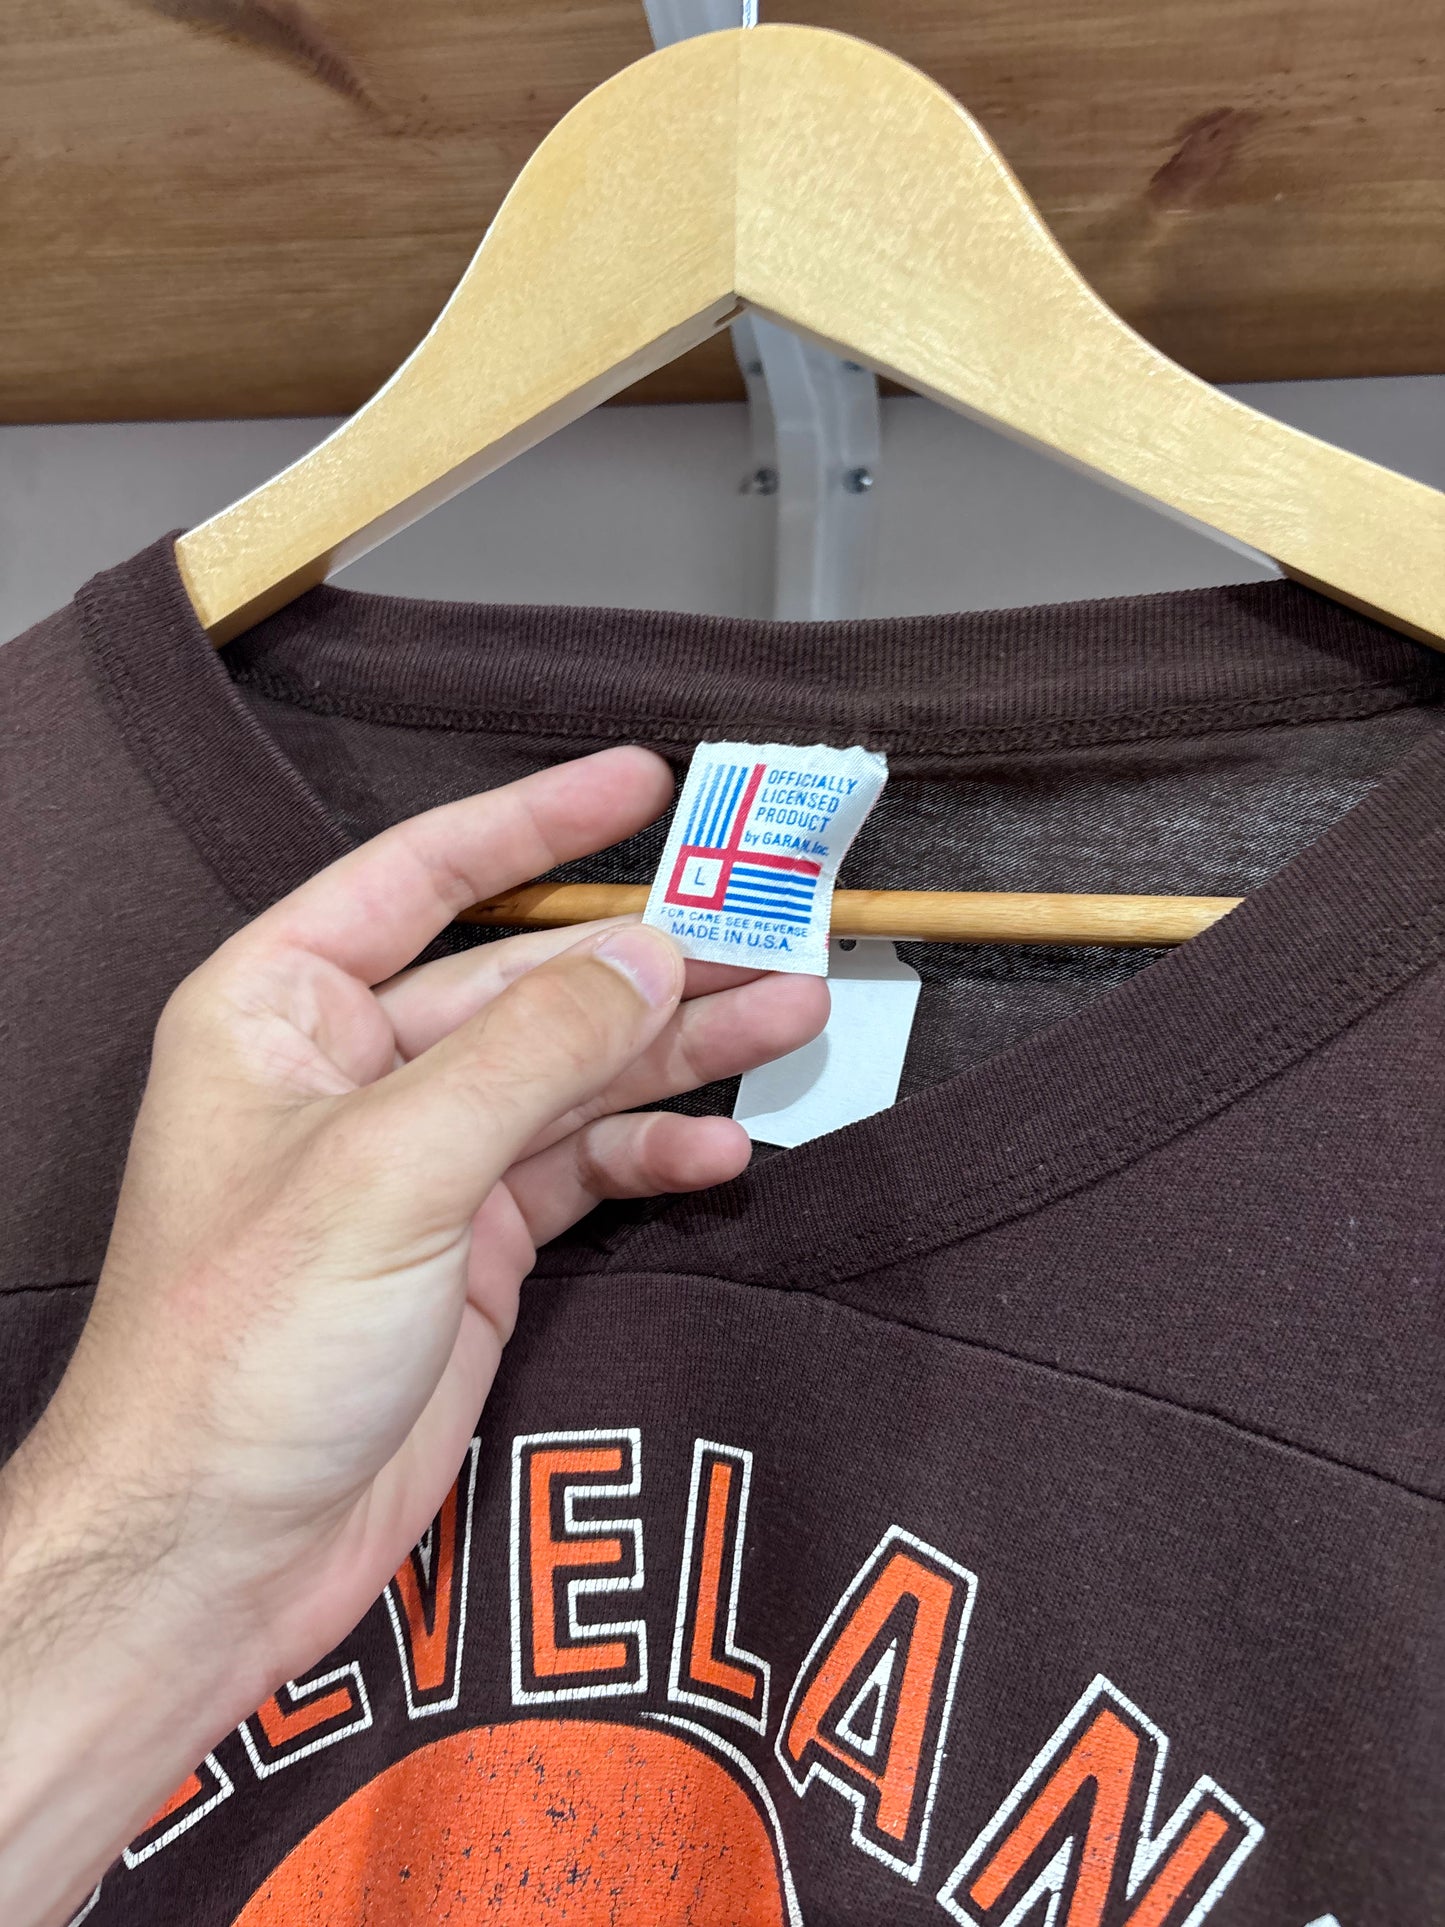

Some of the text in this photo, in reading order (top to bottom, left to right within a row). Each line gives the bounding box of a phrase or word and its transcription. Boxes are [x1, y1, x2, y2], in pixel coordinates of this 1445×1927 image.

[768, 769, 858, 795] OFFICIALLY
[761, 789, 840, 814] LICENSED
[755, 807, 831, 833] PRODUCT
[744, 830, 759, 845] by
[694, 866, 706, 887] L
[661, 907, 809, 938] FOR CARE SEE REVERSE
[671, 921, 793, 952] MADE IN U.S.A.
